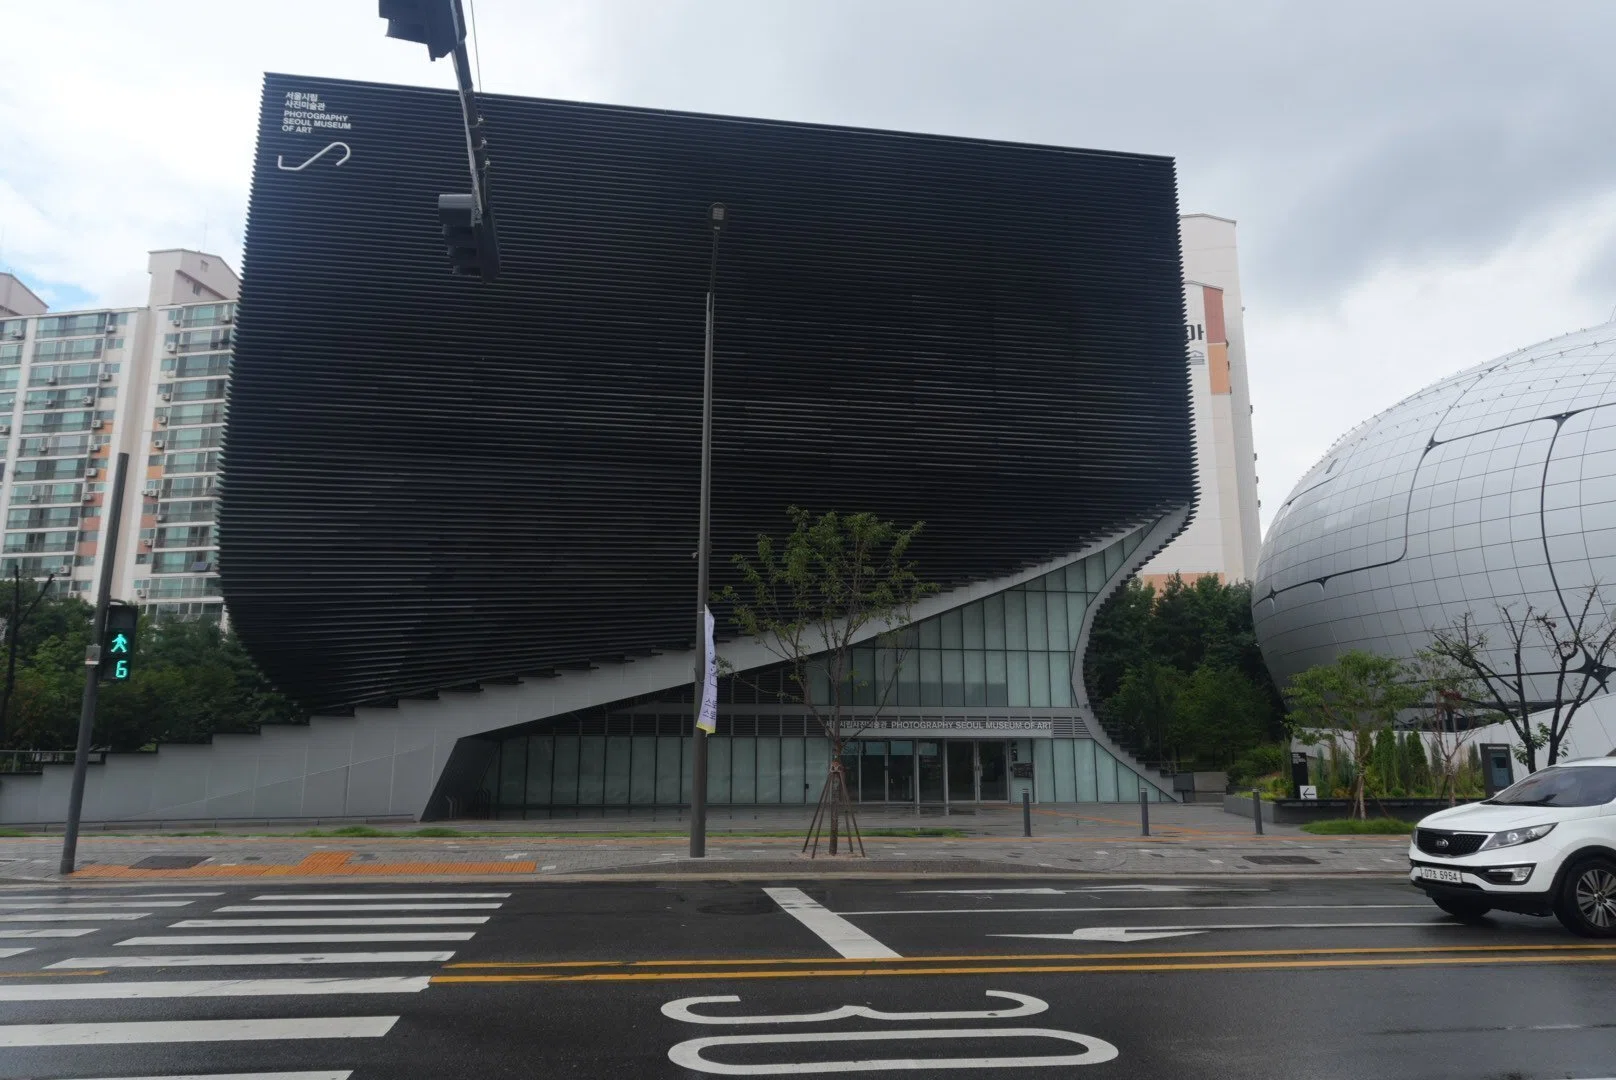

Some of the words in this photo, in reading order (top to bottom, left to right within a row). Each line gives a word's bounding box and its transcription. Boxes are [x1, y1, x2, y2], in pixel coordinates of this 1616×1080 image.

[286, 92, 318, 102] 서울시립
[284, 100, 326, 111] 사진미술관
[284, 111, 348, 121] PHOTOGRAPHY
[283, 118, 312, 126] SEOUL
[313, 121, 351, 129] MUSEUM
[115, 660, 128, 678] 6
[891, 721, 953, 729] PHOTOGRAPHY
[956, 721, 983, 729] SEOUL
[986, 721, 1021, 729] MUSEUM
[1024, 721, 1035, 729] OF
[1037, 721, 1052, 729] ART
[1440, 870, 1457, 881] 5954
[660, 989, 1119, 1076] 30
